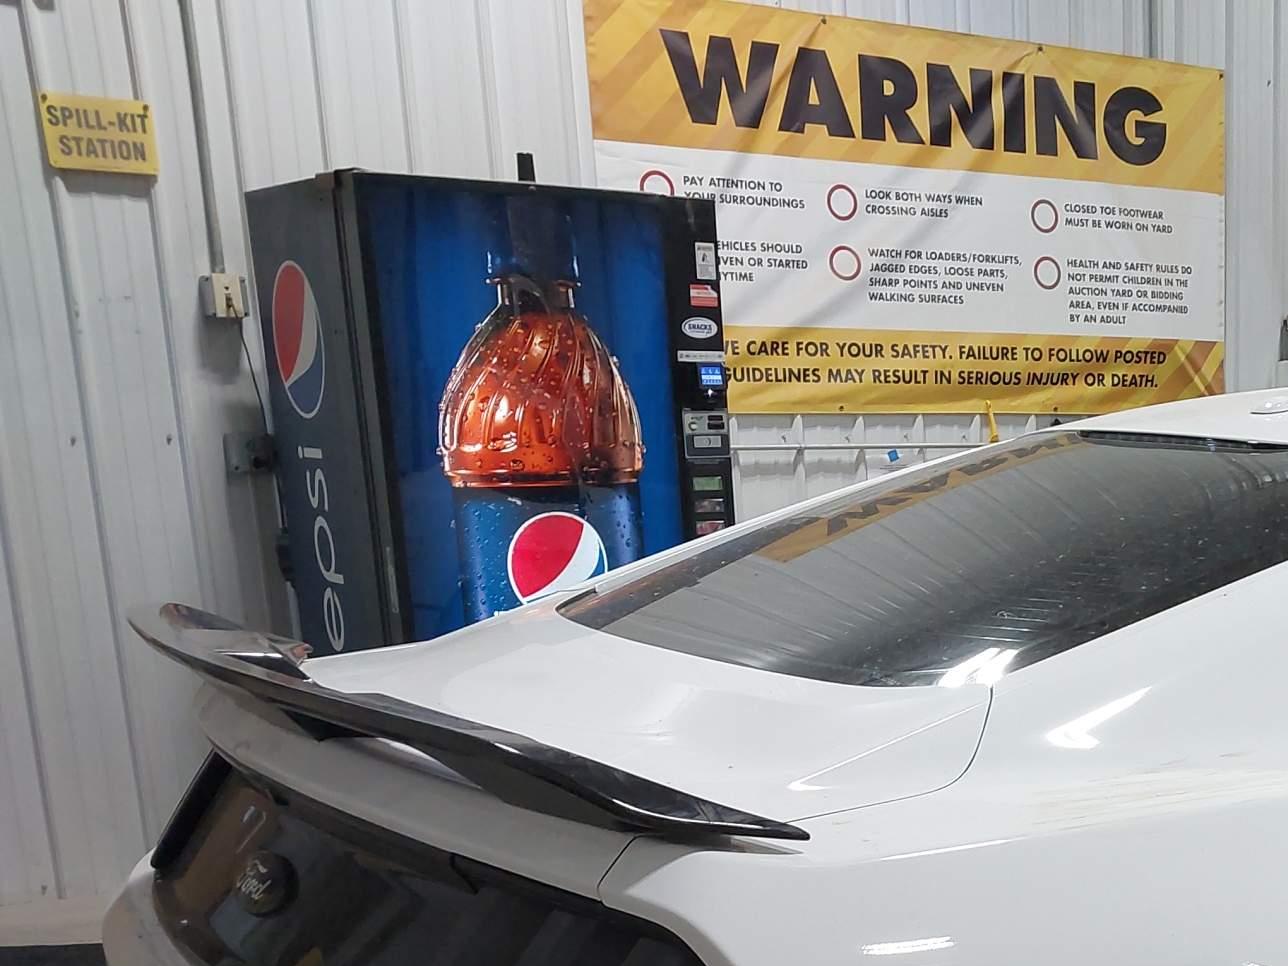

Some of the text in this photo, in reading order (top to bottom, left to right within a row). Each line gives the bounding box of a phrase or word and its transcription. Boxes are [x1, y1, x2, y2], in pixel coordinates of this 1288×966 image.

[659, 28, 1167, 166] WARNING
[46, 105, 148, 134] SPILL-KIT
[58, 135, 146, 162] STATION
[683, 176, 782, 192] PAY ATTENTION TO
[720, 194, 805, 208] SURROUNDINGS
[866, 190, 982, 206] LOOK BOTH WAYS WHEN
[866, 204, 948, 217] CROSSING AISLES
[1064, 204, 1164, 220] CLOSED TOE FOOTWEAR
[1065, 218, 1172, 233] MUST BE WORN ON YARD
[717, 240, 756, 251] EHICLES
[761, 242, 802, 253] SHOULD
[748, 257, 763, 267] OR
[767, 259, 807, 269] STARTED
[868, 248, 1022, 265] WATCH FOR LOADERS/FORKLIFTS,
[870, 264, 1007, 279] JAGGED EDGES, LOOSE PARTS,
[1067, 259, 1192, 274] HEALTH AND SAFETY RULES DO
[869, 278, 1003, 291] SHARP POINTS AND UNEVEN
[1068, 273, 1188, 287] NOT PERMIT CHILDREN IN THE
[868, 292, 964, 304] WALKING SURFACES
[1068, 287, 1183, 300] AUCTION YARD OR BIDDING
[1069, 301, 1188, 314] AREA, EVEN IF ACCOMPANIED
[1070, 314, 1126, 324] BY AN ADULT
[747, 341, 789, 357] CARE
[796, 342, 830, 357] FOR
[836, 342, 884, 358] YOUR
[891, 343, 952, 360] SAFETY.
[959, 345, 1017, 361] FAILURE
[1023, 347, 1042, 362] TO
[1049, 348, 1110, 364] FOLLOW
[1114, 350, 1166, 365] POSTED
[828, 369, 865, 383] MAY
[872, 369, 929, 385] RESULT
[935, 370, 951, 384] IN
[958, 370, 1021, 386] SERIOUS
[1026, 372, 1079, 386] INJURY
[1084, 373, 1105, 387] OR
[1112, 374, 1158, 388] DEATH.
[298, 445, 345, 652] epsi
[236, 859, 272, 900] Ford
